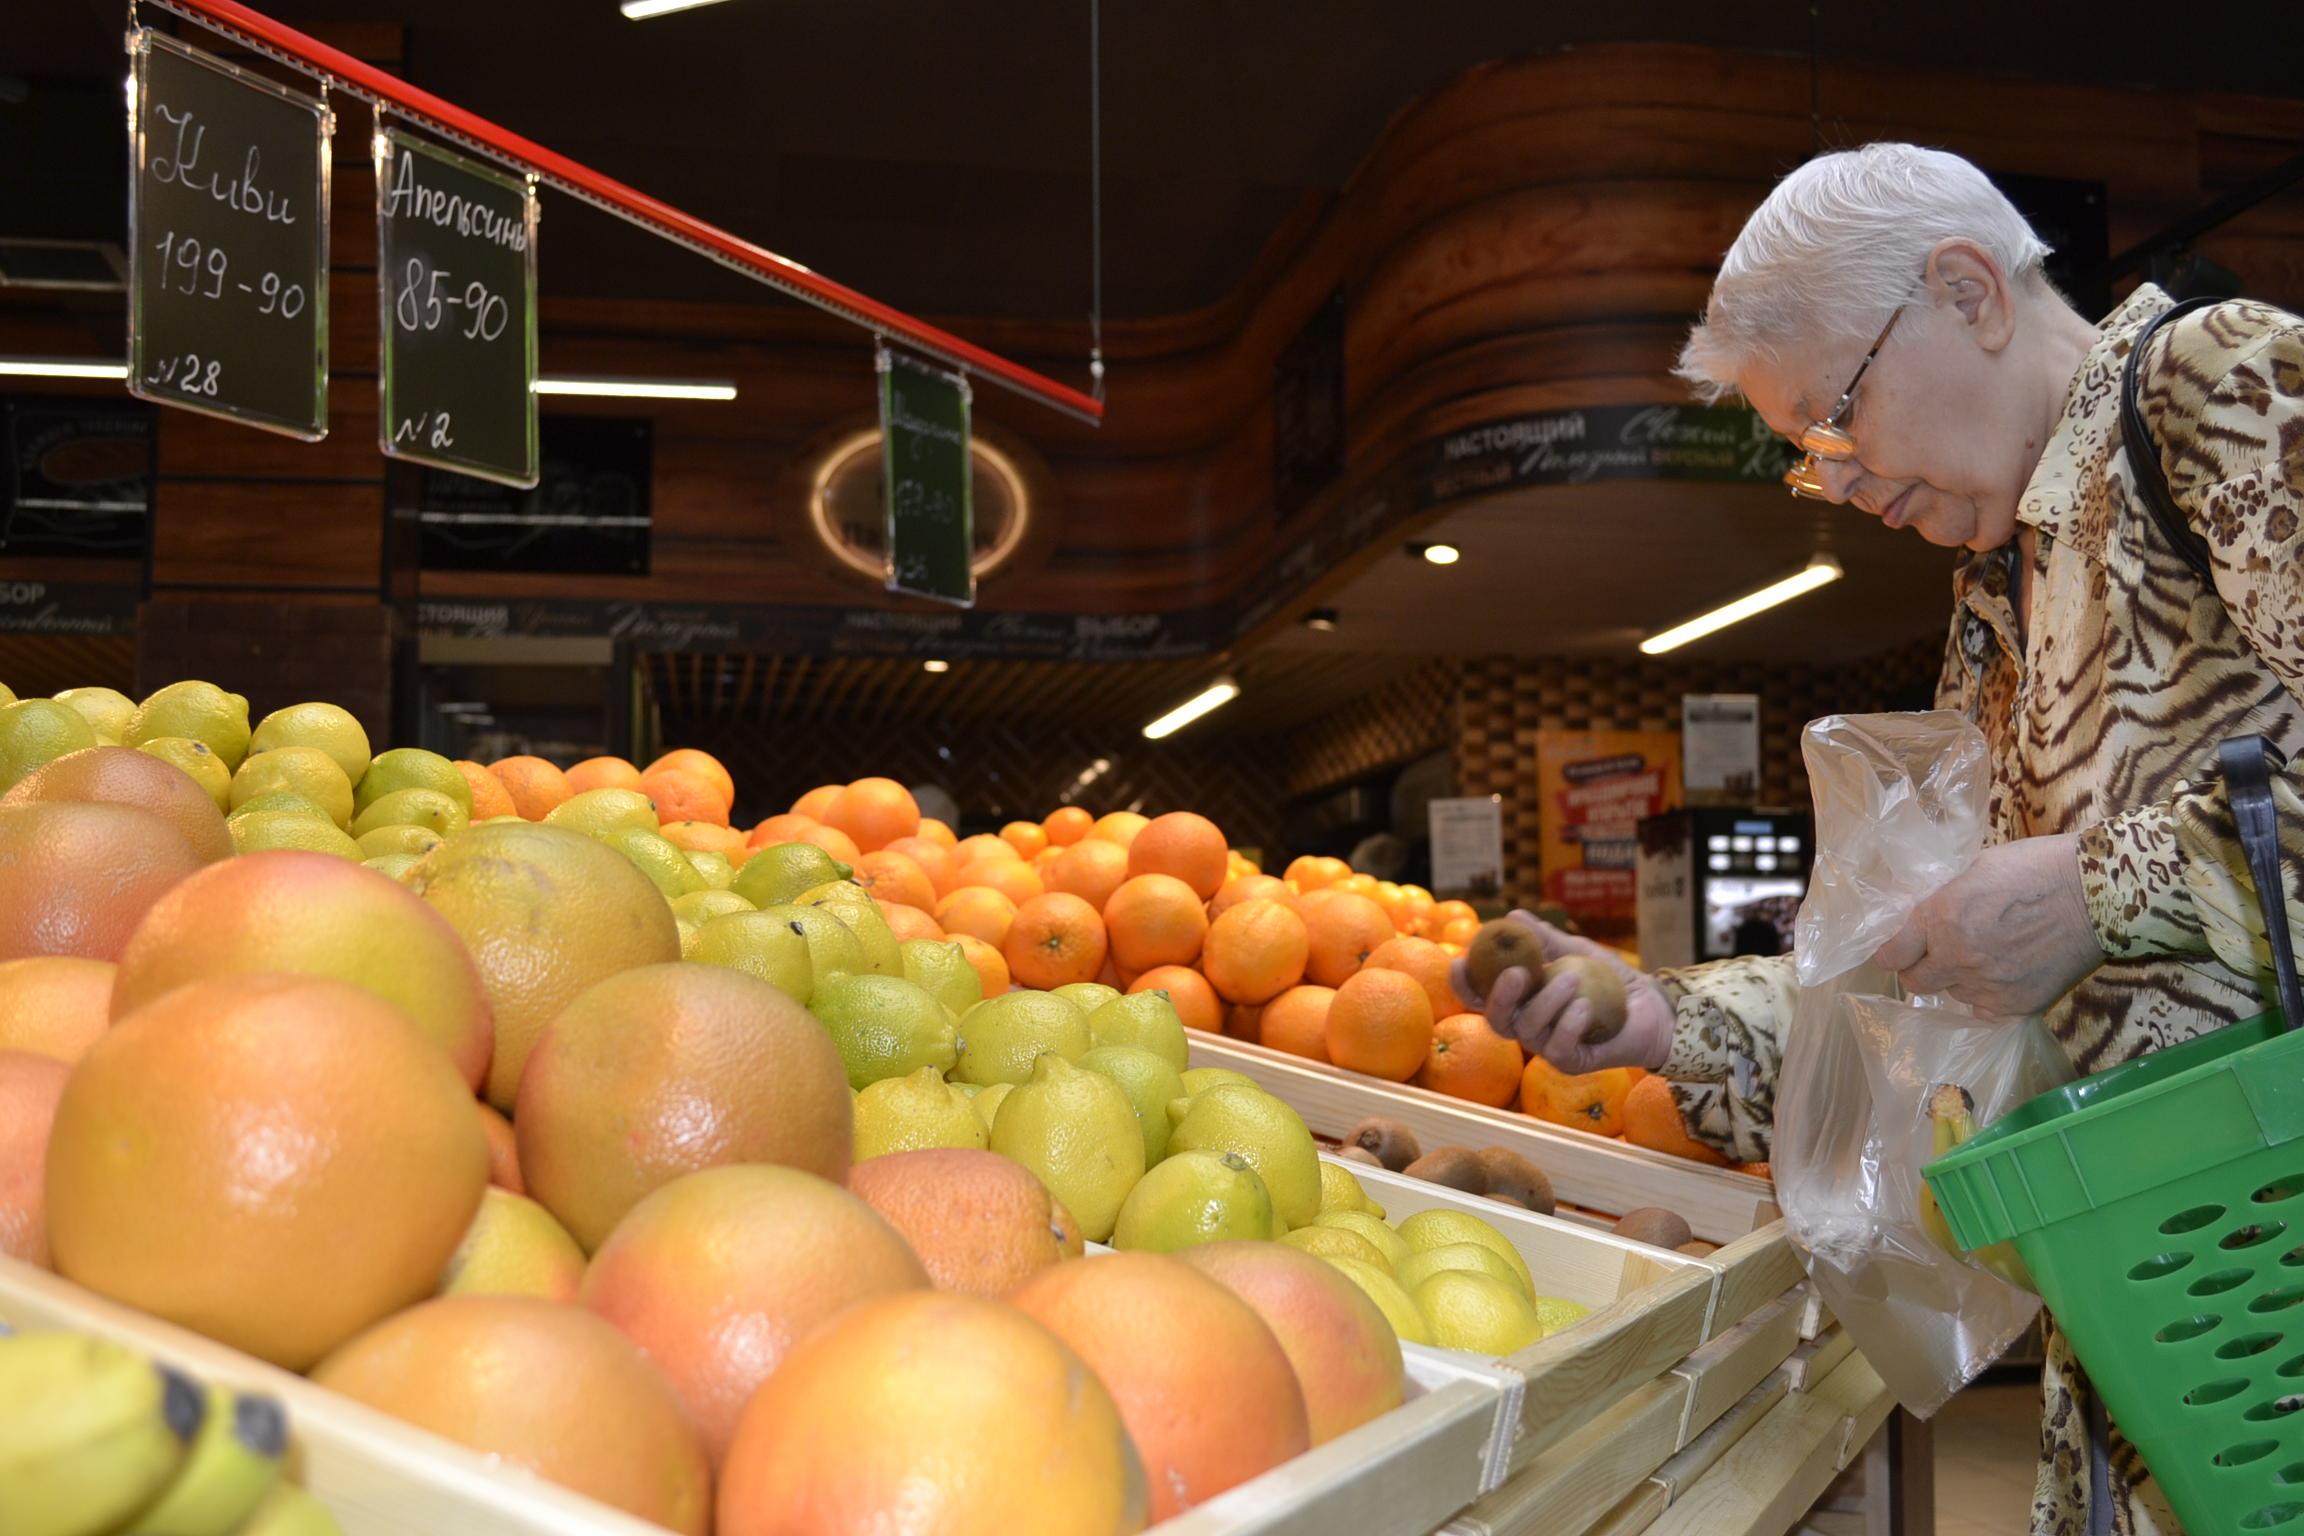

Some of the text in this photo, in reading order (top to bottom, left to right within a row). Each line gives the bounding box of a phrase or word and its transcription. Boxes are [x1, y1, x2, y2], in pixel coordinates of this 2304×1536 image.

[151, 103, 296, 224] Киви
[155, 231, 306, 319] 199-90
[397, 257, 509, 341] 85-90
